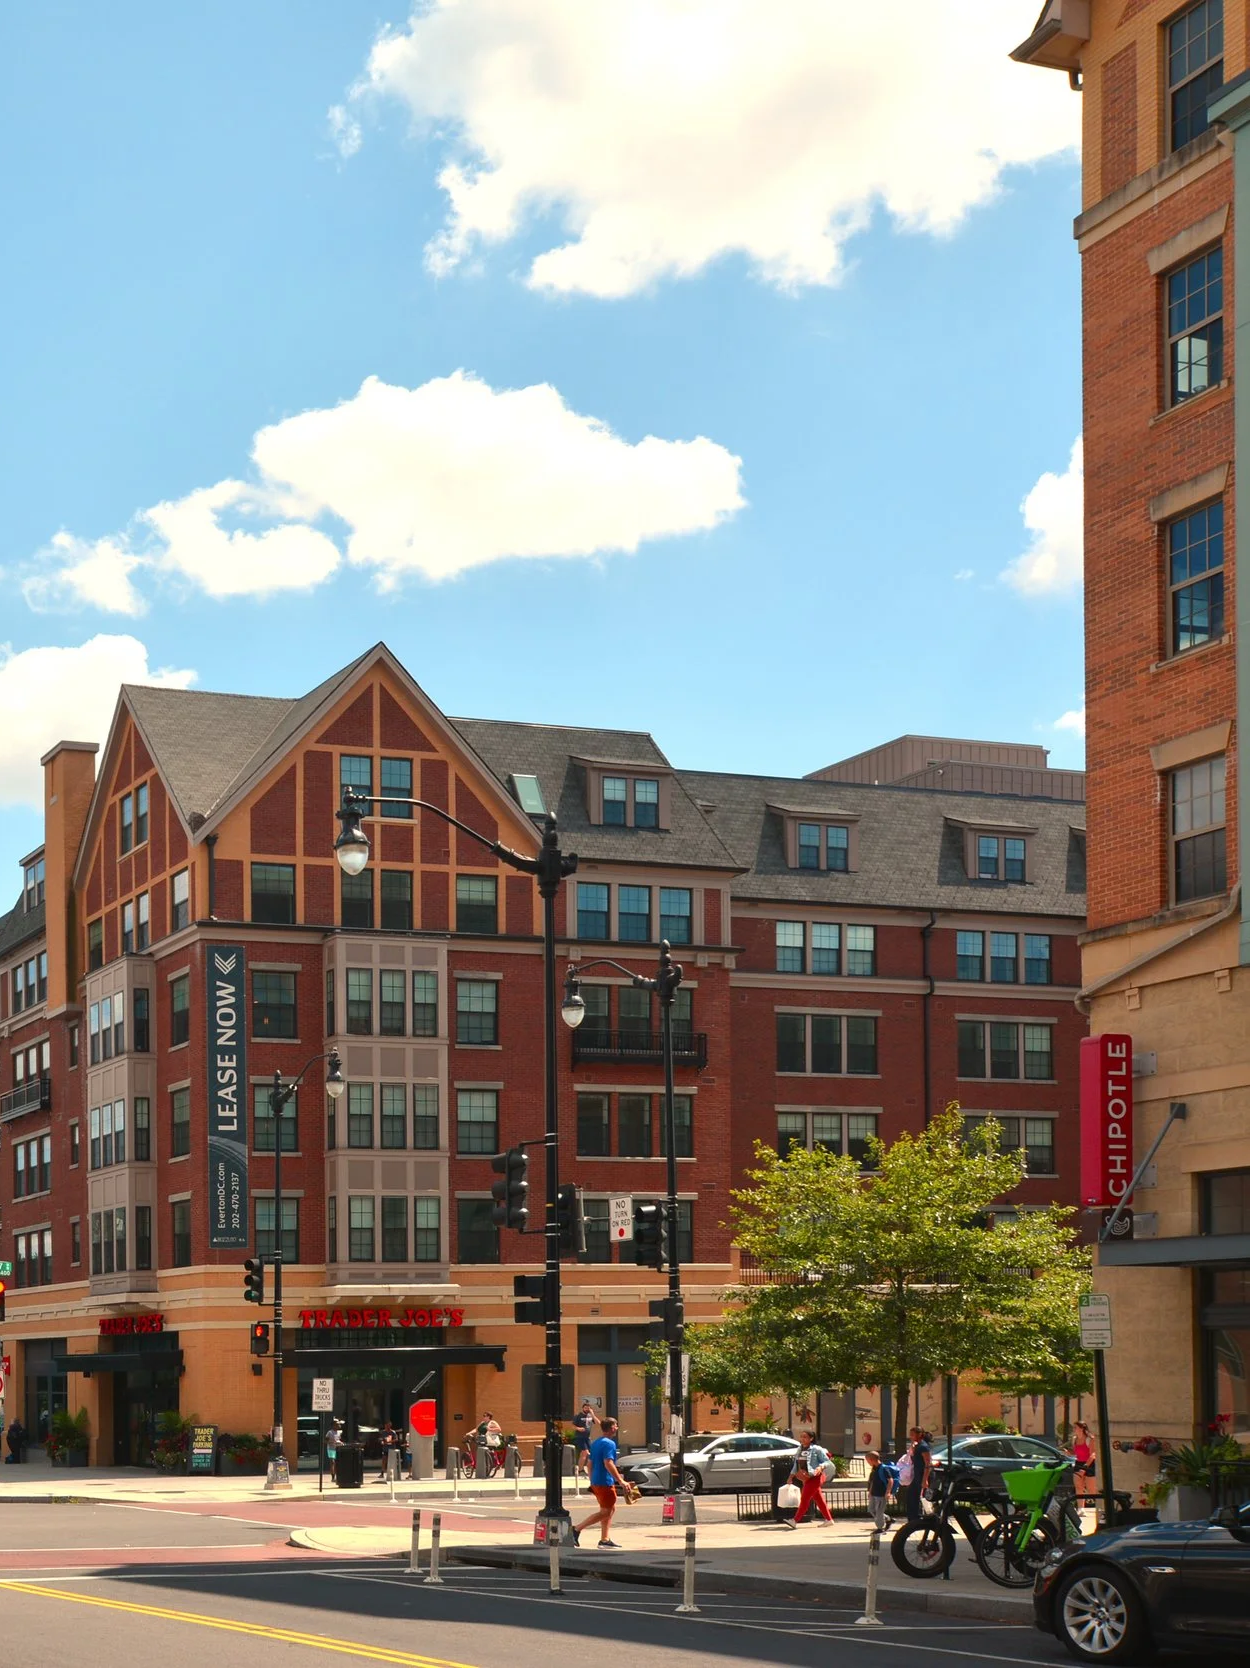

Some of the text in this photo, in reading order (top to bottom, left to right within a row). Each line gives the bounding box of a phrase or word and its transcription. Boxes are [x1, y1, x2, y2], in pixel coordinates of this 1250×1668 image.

[216, 981, 237, 1131] LEASE NOW
[1108, 1042, 1128, 1197] CHIPOTLE
[217, 1162, 226, 1229] EvertonDC.com
[231, 1172, 240, 1229] 202-470-2137
[615, 1200, 626, 1209] NO
[1082, 1296, 1088, 1306] 2
[99, 1314, 164, 1335] TRADER JOE'S
[298, 1307, 465, 1329] TRADER JOE'S
[192, 1441, 213, 1449] PARKING
[194, 1434, 212, 1442] JOE'S
